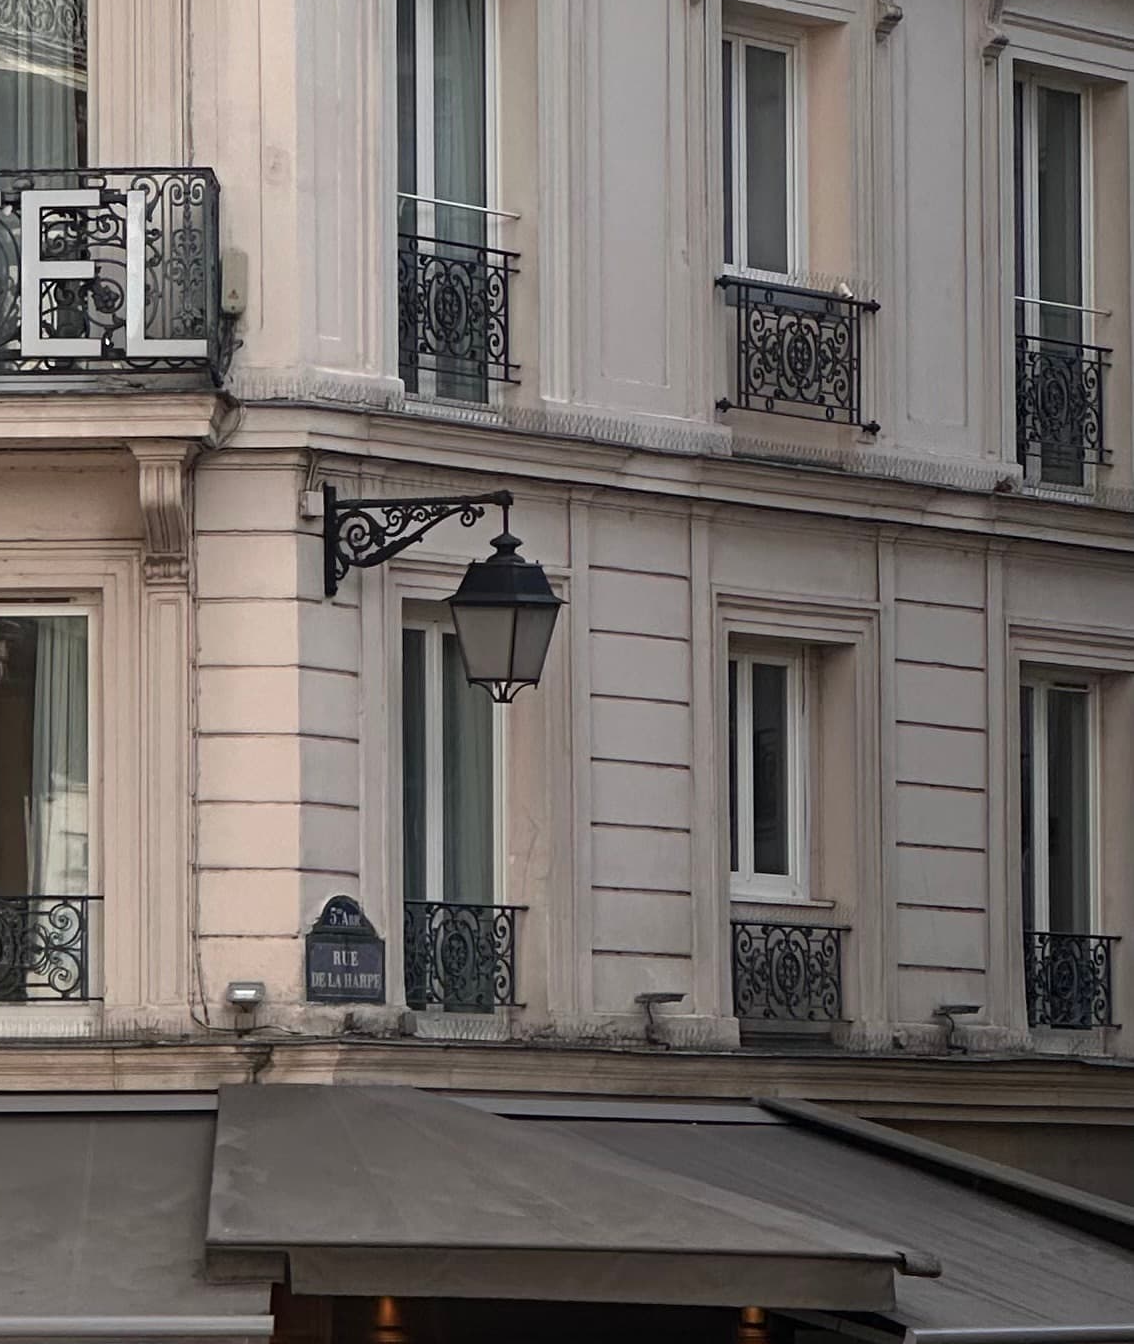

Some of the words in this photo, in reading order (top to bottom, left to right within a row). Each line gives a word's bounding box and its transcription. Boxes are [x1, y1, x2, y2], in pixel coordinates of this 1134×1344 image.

[333, 950, 359, 966] RUE
[311, 972, 325, 988] DE
[328, 972, 341, 988] LA
[344, 973, 383, 990] HARPE
